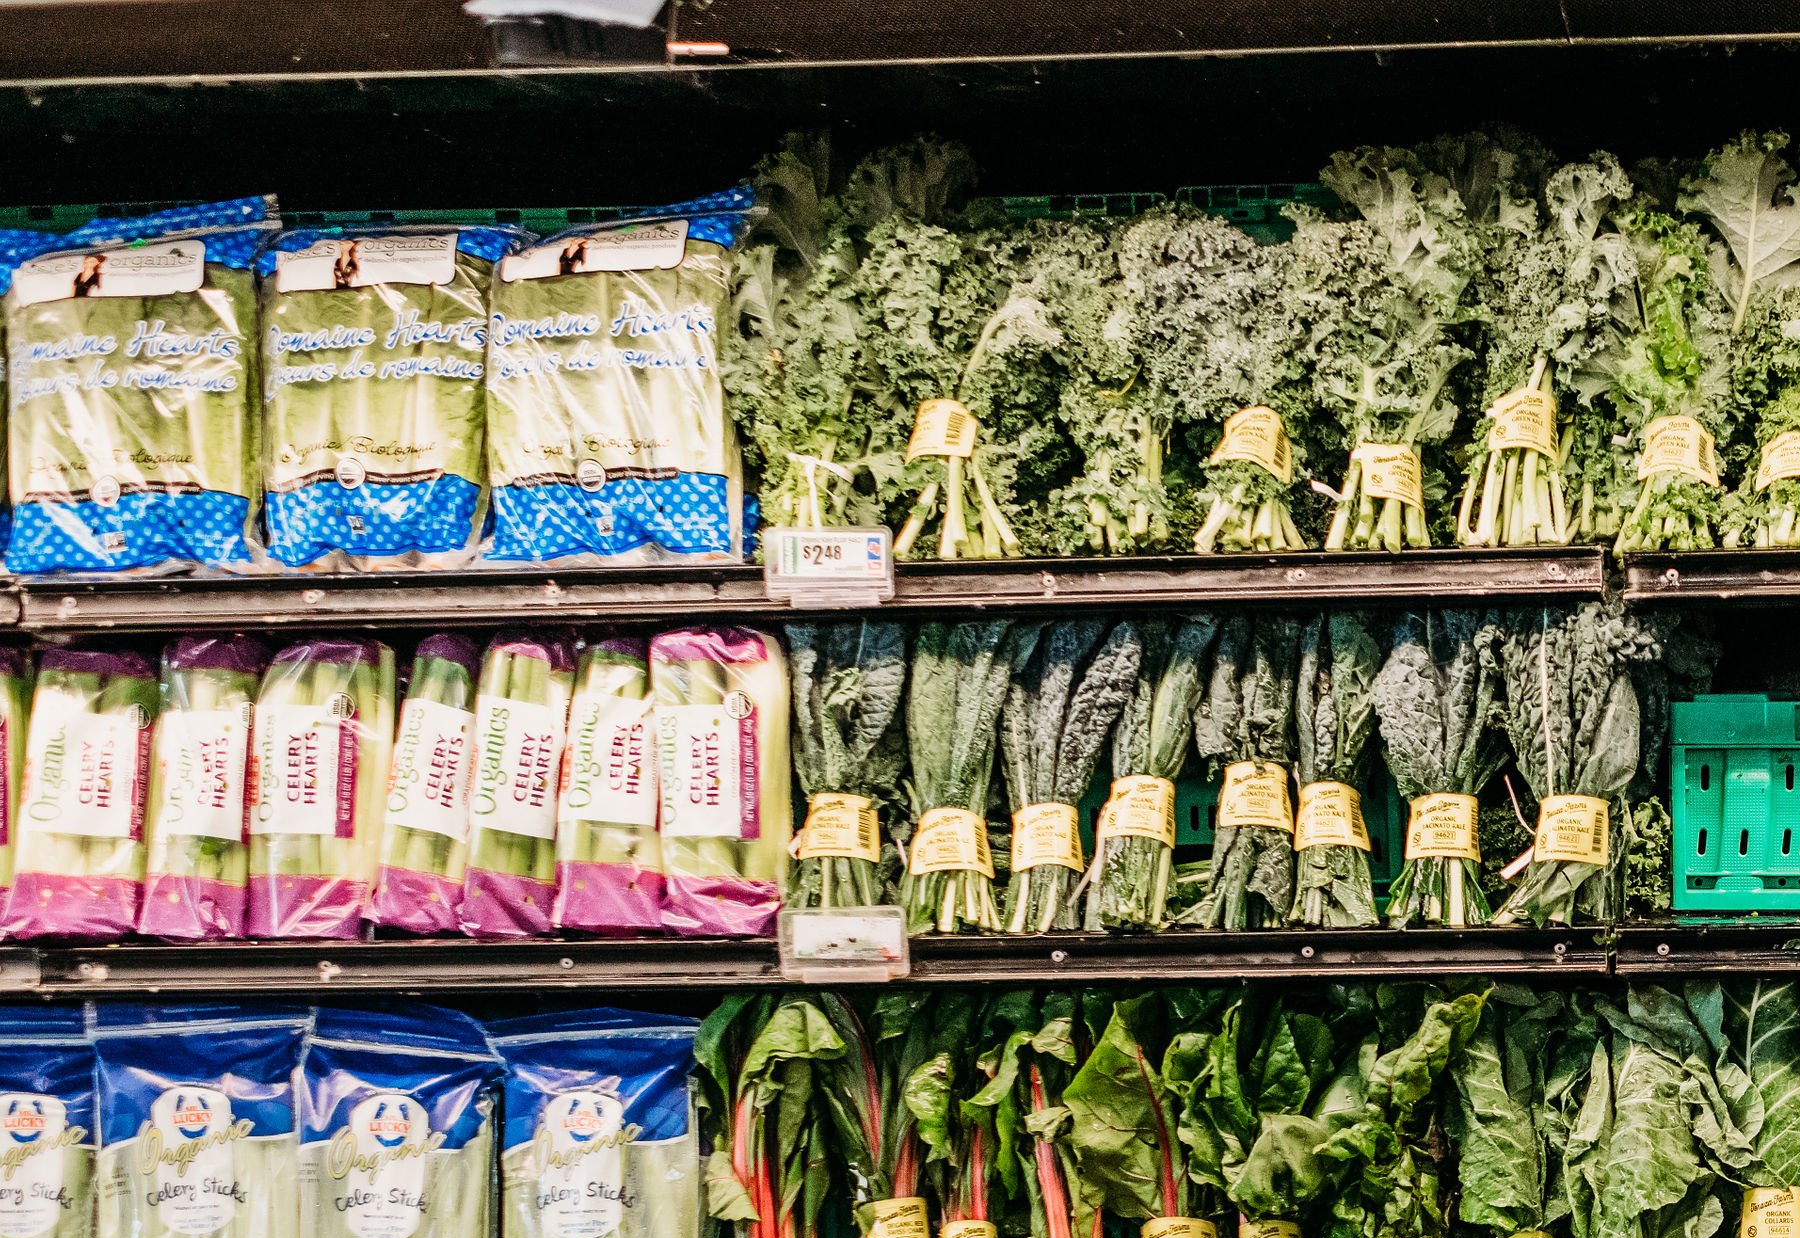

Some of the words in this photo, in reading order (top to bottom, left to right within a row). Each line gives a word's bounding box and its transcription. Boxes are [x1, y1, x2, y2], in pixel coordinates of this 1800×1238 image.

[131, 320, 240, 358] Hearts
[387, 309, 490, 350] Hearts
[490, 312, 602, 347] Romaine
[609, 302, 718, 338] Hearts
[343, 351, 377, 380] de
[381, 361, 485, 381] romaine
[568, 342, 602, 371] de
[83, 359, 118, 389] de
[124, 368, 238, 392] romaine
[1511, 416, 1530, 424] GREEN
[1530, 418, 1543, 426] KALE
[1515, 409, 1540, 418] ORGANIC
[1673, 442, 1690, 450] KALE
[803, 544, 842, 566] $248
[78, 740, 95, 805] CELERY
[211, 737, 230, 809] HEARTS
[258, 713, 280, 822] Organics
[286, 733, 304, 802] CELERY
[303, 731, 320, 805] HEARTS
[387, 706, 426, 813] Organics
[424, 732, 455, 802] CELERY
[440, 735, 464, 809] HEARTS
[474, 706, 511, 815] Organics
[513, 732, 538, 803] CELERY
[529, 734, 554, 809] HEARTS
[607, 723, 631, 792] CELERY
[625, 722, 645, 796] HEARTS
[661, 715, 684, 826] Organics
[689, 734, 708, 805] CELERY
[706, 731, 720, 806] HEARTS
[96, 740, 115, 809] HEARTS
[1423, 822, 1451, 830] LACINATO
[1451, 822, 1466, 831] KALE
[1430, 815, 1457, 823] ORGANIC
[1556, 818, 1583, 826] ORGANIC
[1575, 826, 1590, 835] KALE
[1434, 831, 1455, 839] 94621
[1557, 834, 1579, 843] 94621
[4, 1114, 49, 1129] LUCKY
[173, 1111, 213, 1125] LUCKY
[368, 1119, 412, 1135] LUCKY
[562, 1116, 604, 1130] LUCKY
[134, 1114, 257, 1177] Organic
[329, 1125, 448, 1186] Organic
[534, 1121, 645, 1175] Organic
[31, 1182, 74, 1210] Sticks
[203, 1177, 247, 1203] Sticks
[586, 1180, 636, 1209] Sticks
[1772, 1191, 1795, 1205] Farms
[1168, 1223, 1191, 1235] Farms
[1763, 1217, 1794, 1225] COLLARDS
[1765, 1210, 1793, 1218] ORGANIC
[1769, 1226, 1792, 1235] 94614
